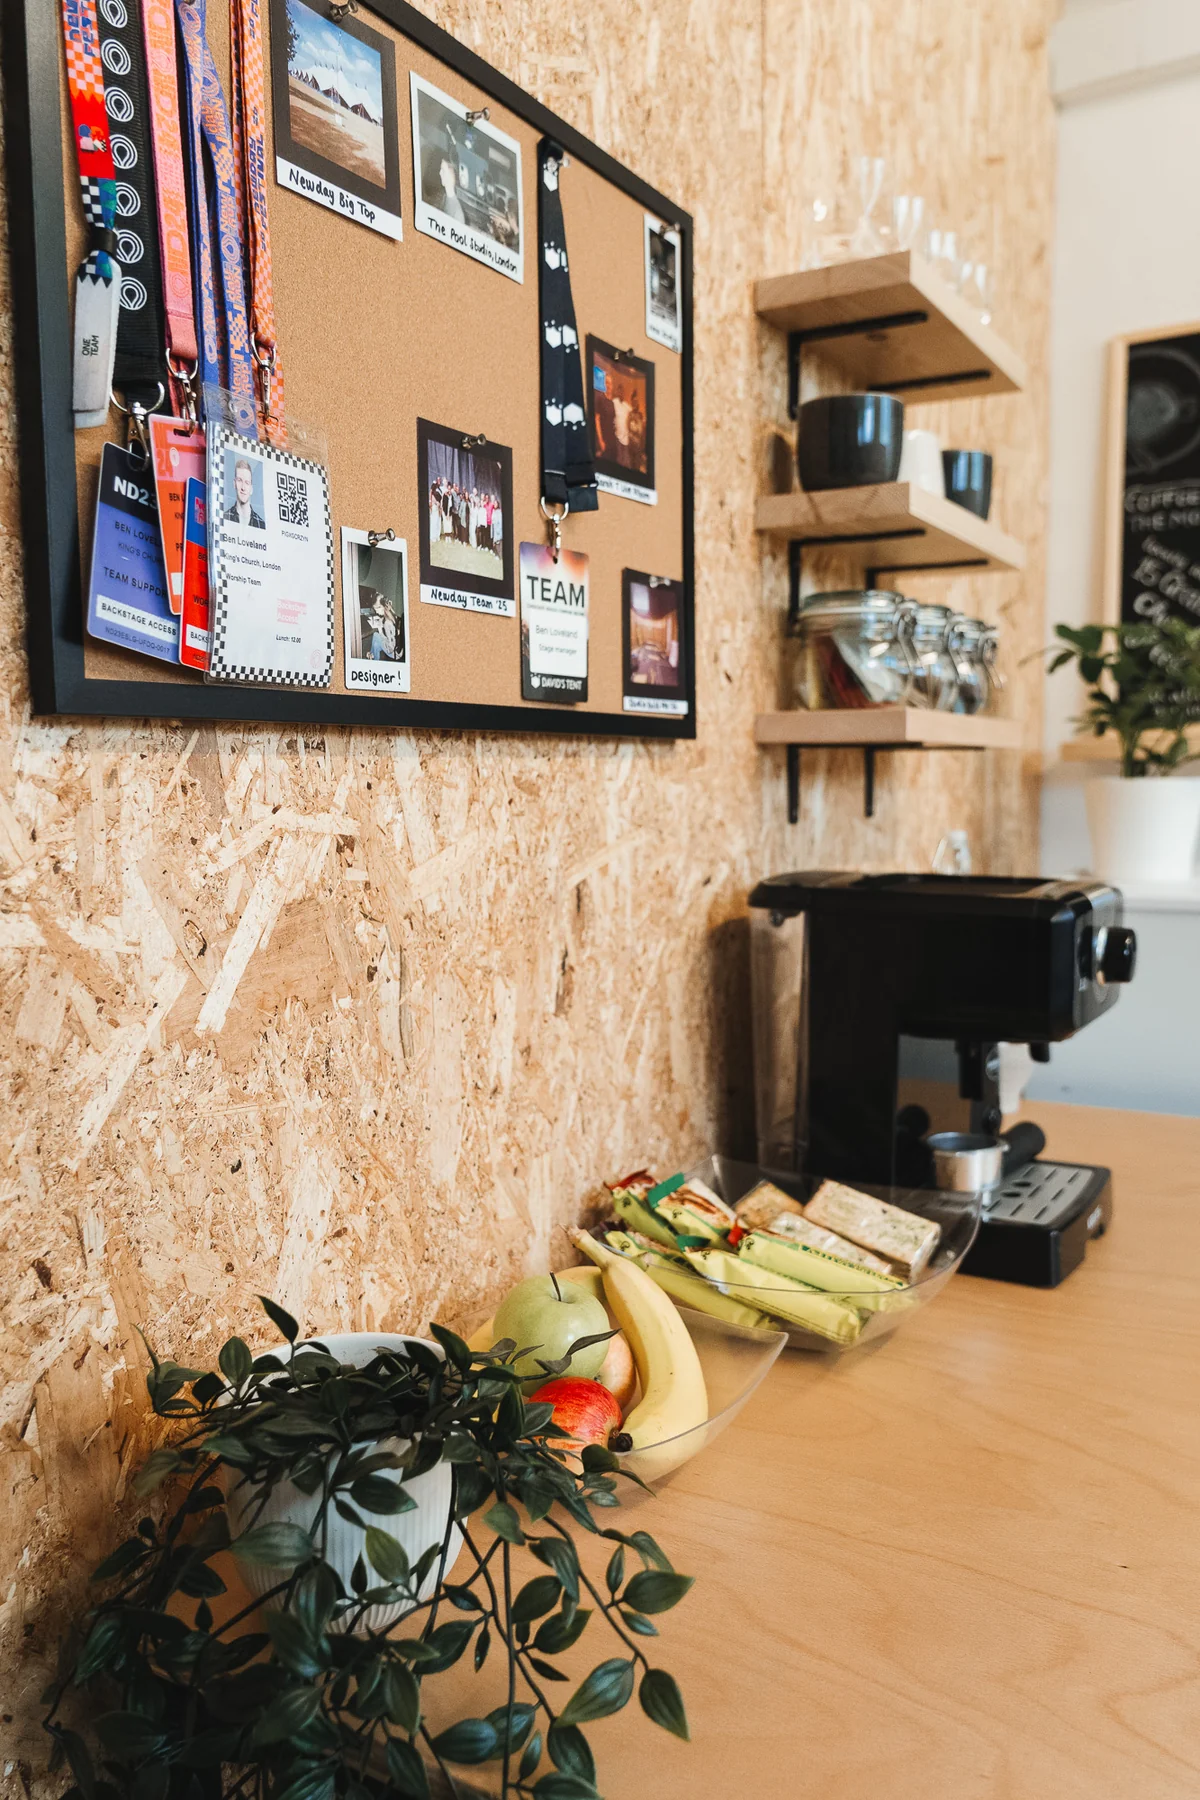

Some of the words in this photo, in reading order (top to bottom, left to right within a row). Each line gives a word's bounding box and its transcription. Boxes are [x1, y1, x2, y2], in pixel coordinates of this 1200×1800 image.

[289, 168, 335, 205] Newday
[339, 192, 355, 215] Big
[357, 201, 375, 223] Top
[428, 217, 446, 236] The
[450, 228, 468, 247] Pool
[82, 338, 91, 356] ONE
[90, 335, 99, 356] TEAM
[114, 521, 131, 534] BEN
[222, 533, 236, 545] Ben
[237, 537, 267, 551] Loveland
[262, 561, 281, 572] London
[103, 566, 129, 584] TEAM
[131, 577, 168, 598] SUPPOR
[226, 573, 247, 584] Worship
[247, 577, 261, 586] Team
[431, 588, 467, 608] Newday
[470, 596, 493, 609] Team
[526, 575, 585, 608] TEAM
[101, 602, 146, 625] BACKSTAGE
[148, 620, 177, 636] ACCESS
[535, 624, 548, 635] Ben
[351, 670, 395, 686] Designer
